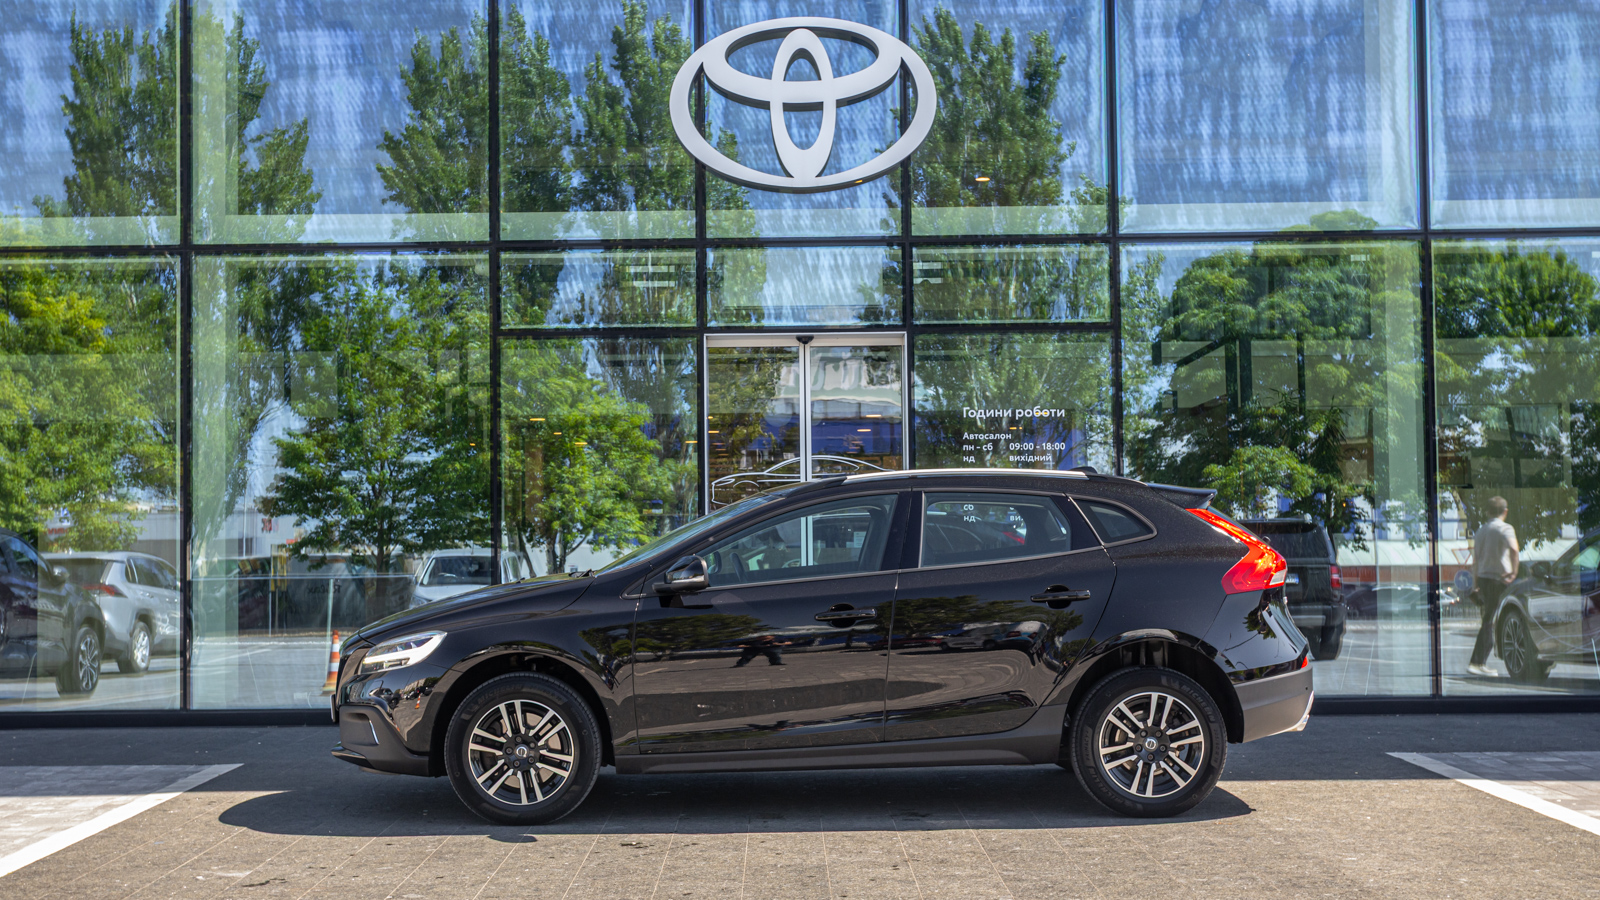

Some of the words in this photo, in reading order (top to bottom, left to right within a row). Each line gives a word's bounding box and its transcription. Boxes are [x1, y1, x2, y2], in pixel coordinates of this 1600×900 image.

[963, 407, 1012, 419] Години
[1016, 406, 1065, 420] роботи
[963, 432, 1012, 440] Автосалон
[982, 442, 993, 451] сб
[1009, 442, 1034, 451] 09:00
[1041, 442, 1066, 451] 18:00
[963, 455, 975, 463] нд
[1009, 454, 1052, 463] вихідний
[963, 515, 976, 523] нд
[1181, 684, 1216, 723] MICHELIN
